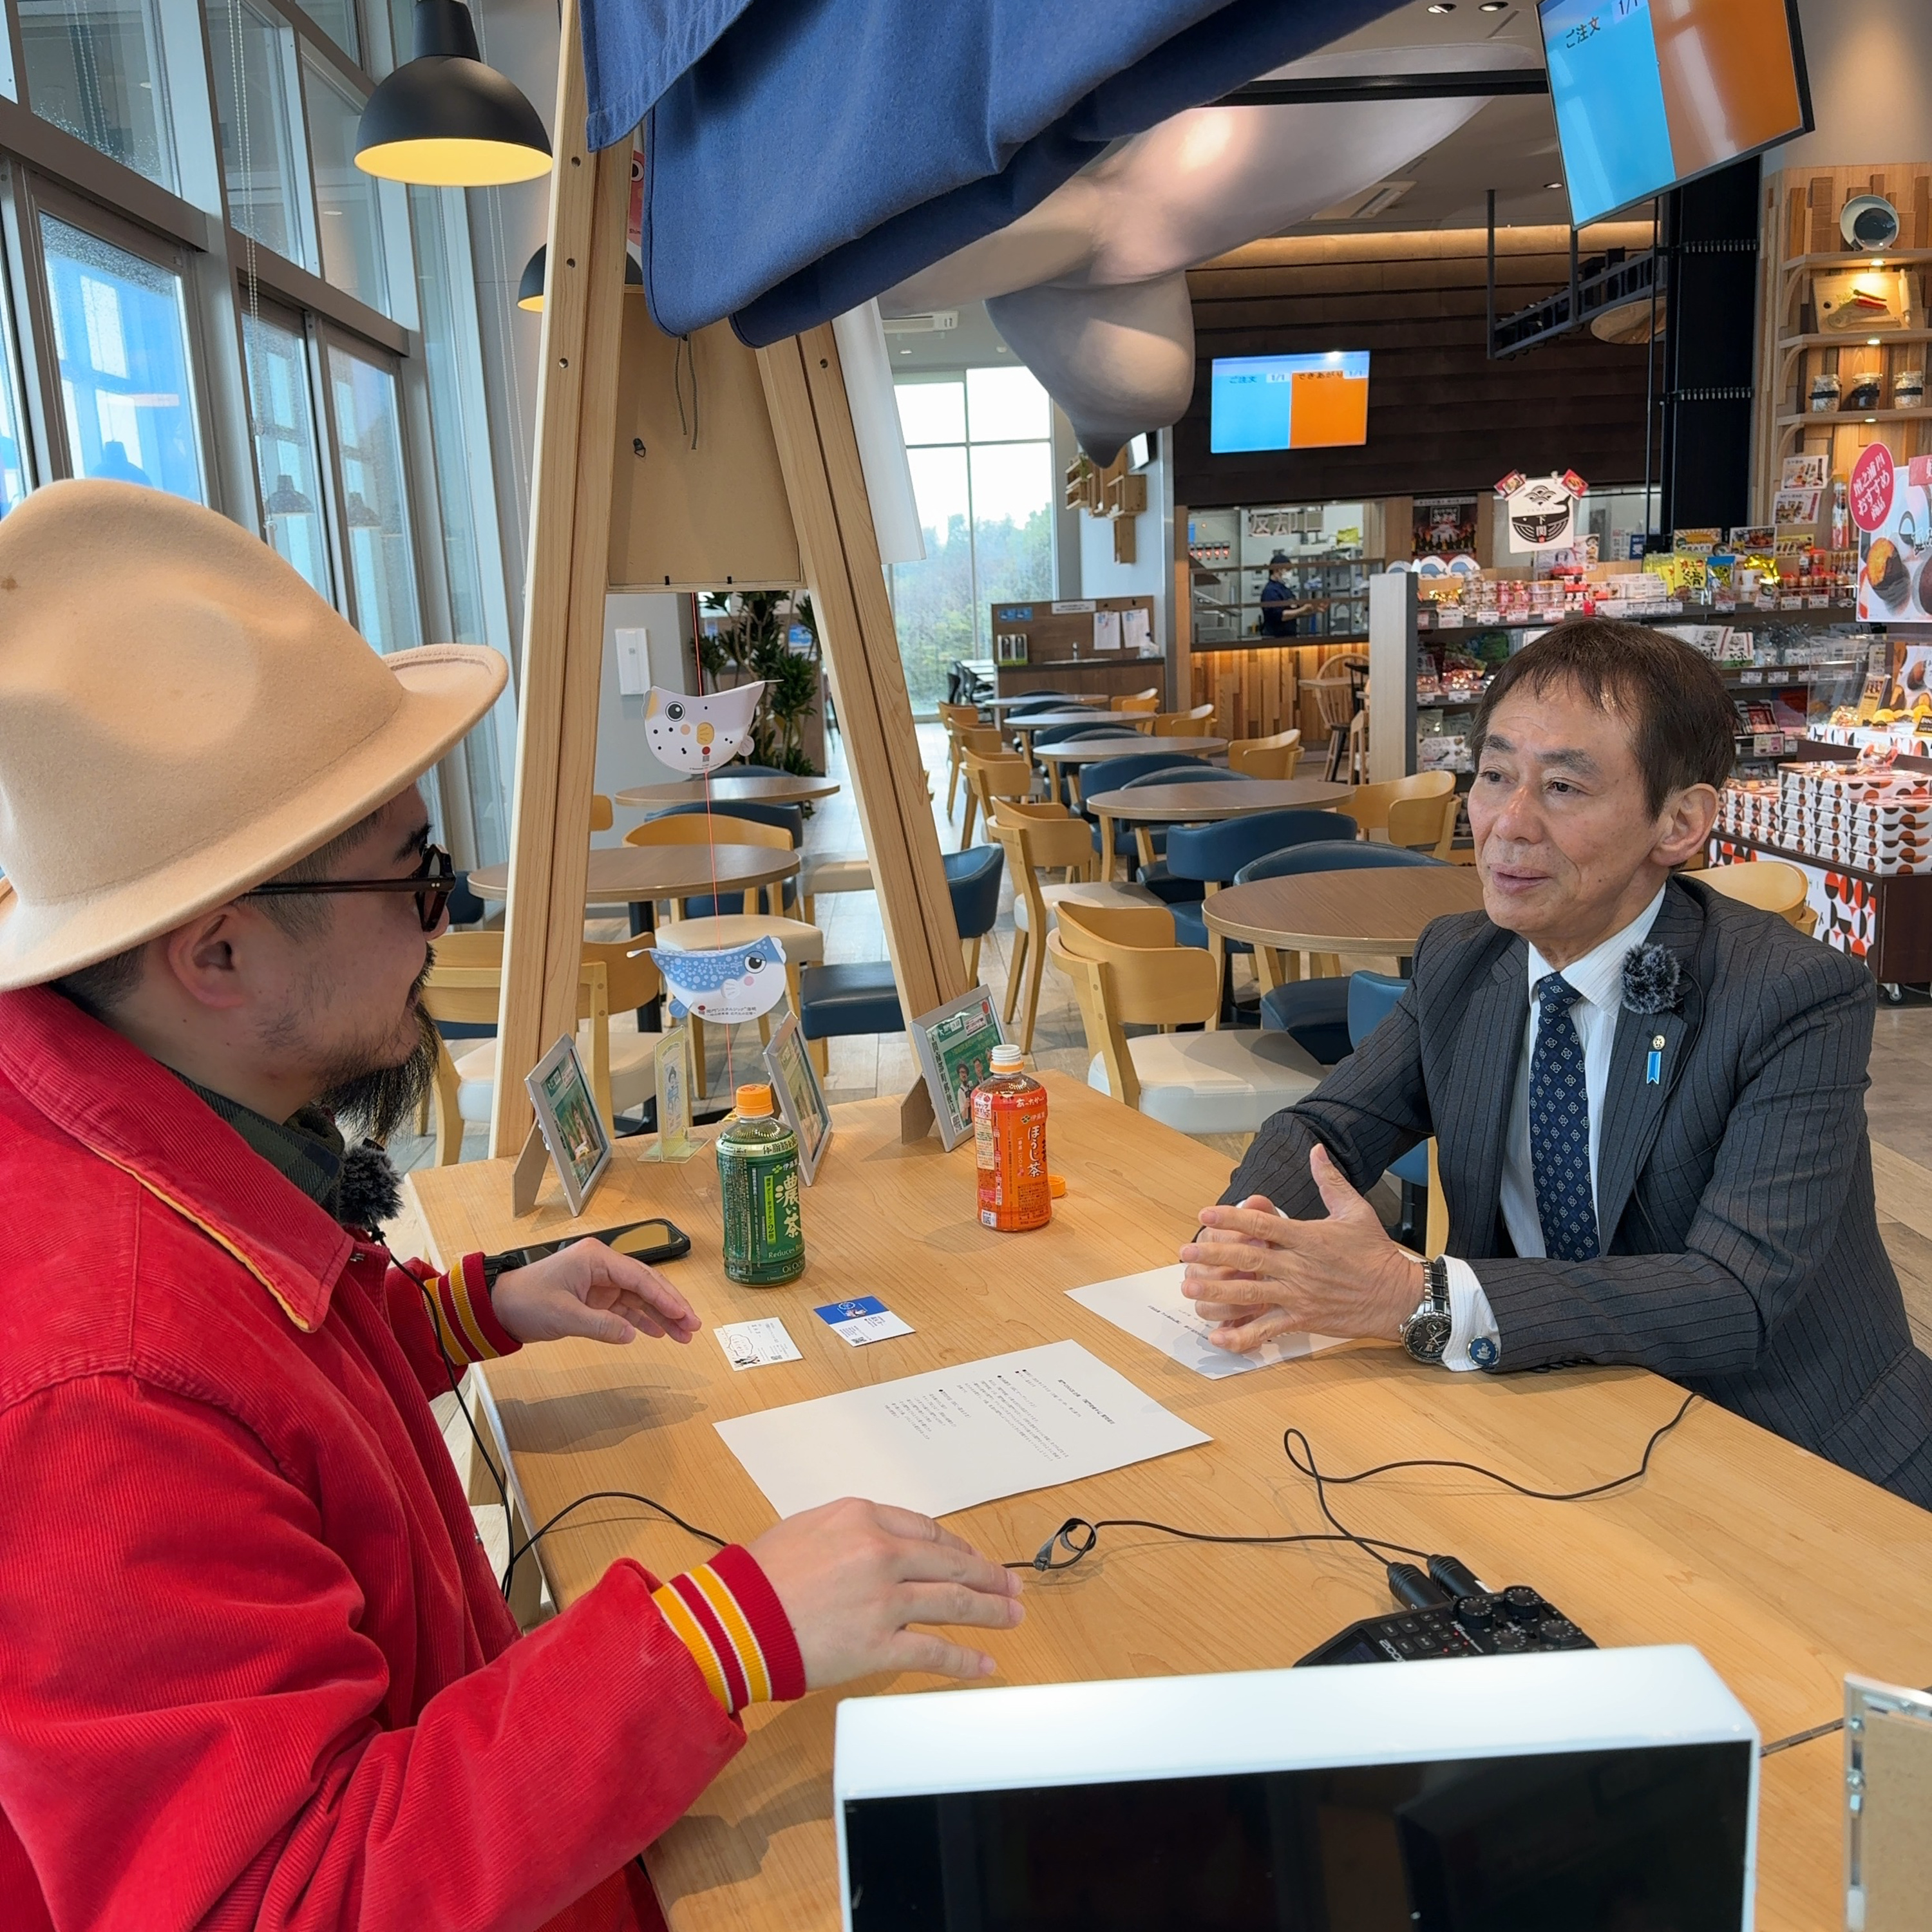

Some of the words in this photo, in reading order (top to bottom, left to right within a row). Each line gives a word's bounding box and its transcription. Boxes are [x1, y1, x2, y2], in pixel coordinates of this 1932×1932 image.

[1566, 17, 1600, 48] ご注文
[1271, 373, 1285, 381] 1/1
[1857, 469, 1890, 516] おすすめ
[1248, 513, 1325, 537] 返却口
[1027, 1125, 1045, 1178] ほうじ茶
[775, 1171, 801, 1238] 濃い茶
[768, 1247, 795, 1258] Reduces
[782, 1264, 791, 1273] Oi
